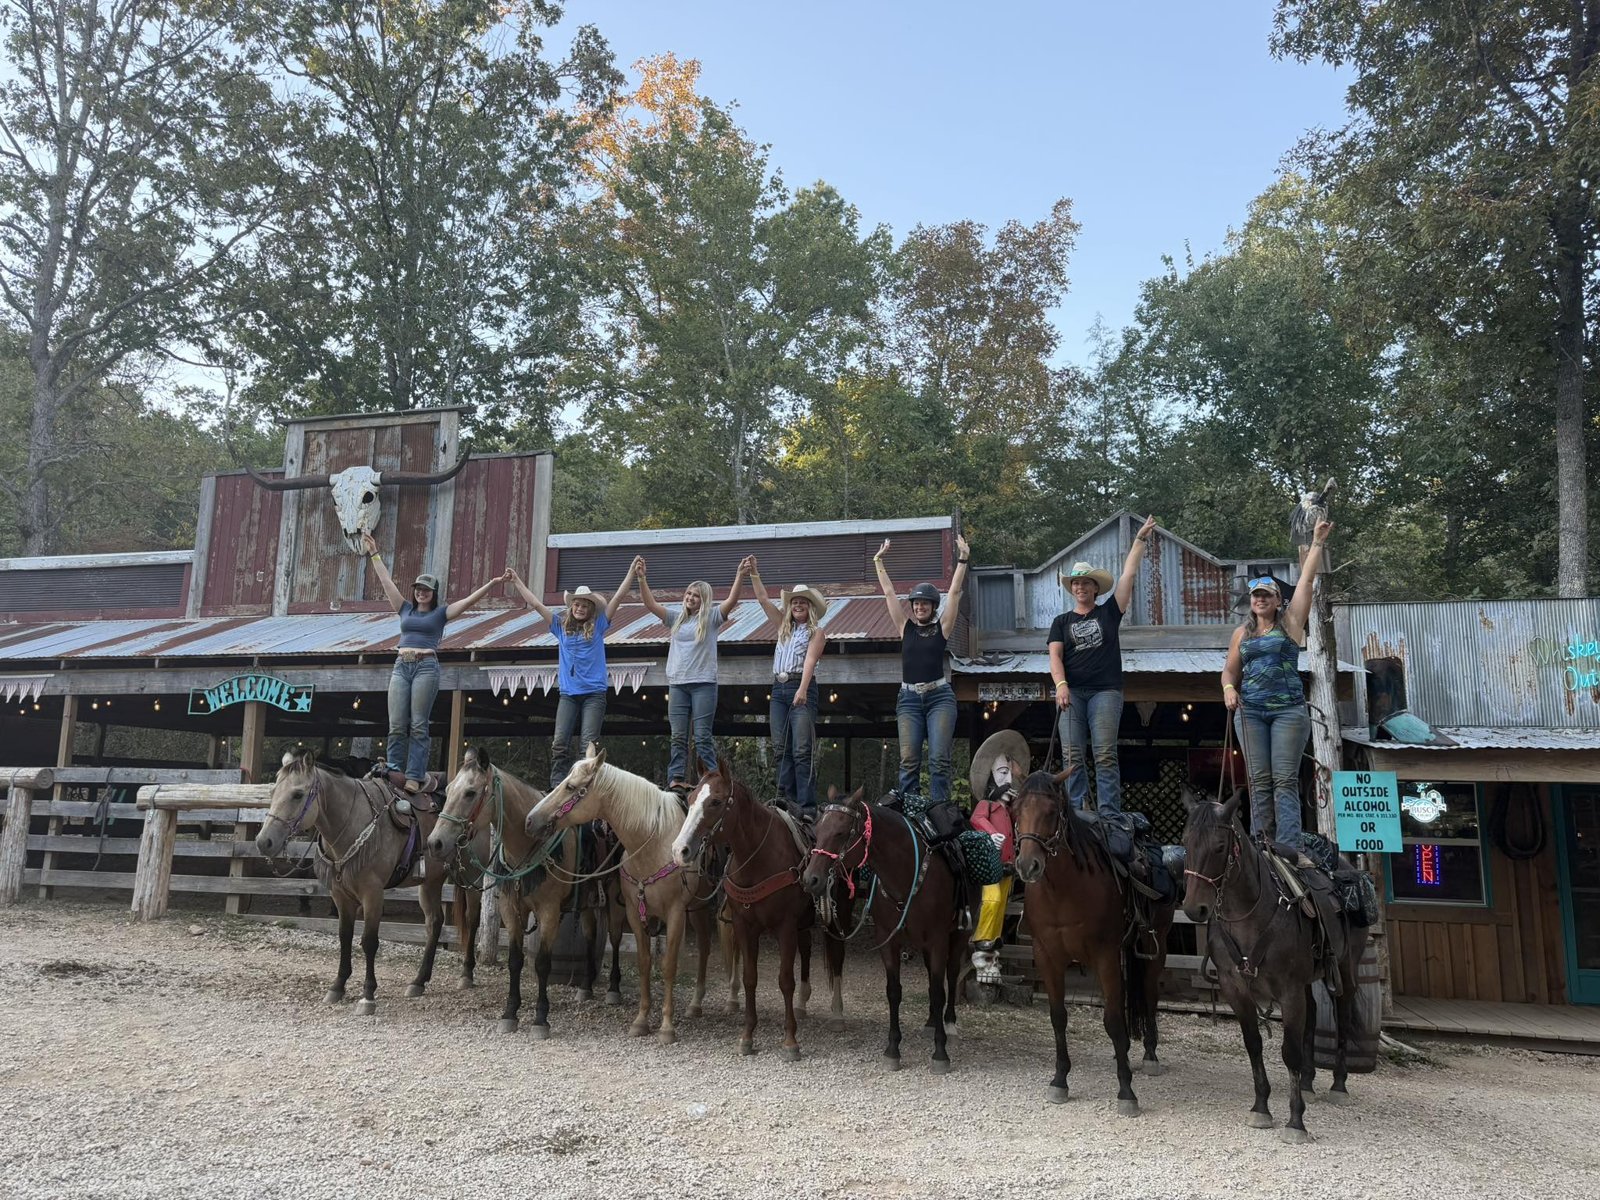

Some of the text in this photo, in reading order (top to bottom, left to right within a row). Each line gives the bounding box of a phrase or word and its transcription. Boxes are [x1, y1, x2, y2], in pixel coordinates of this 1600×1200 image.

[204, 677, 296, 711] WELCOME
[1356, 773, 1371, 784] NO
[1342, 787, 1389, 797] OUTSIDE
[1344, 800, 1391, 812] ALCOHOL
[1411, 806, 1437, 814] BUSCH
[1360, 822, 1376, 832] OR
[1355, 839, 1384, 850] FOOD
